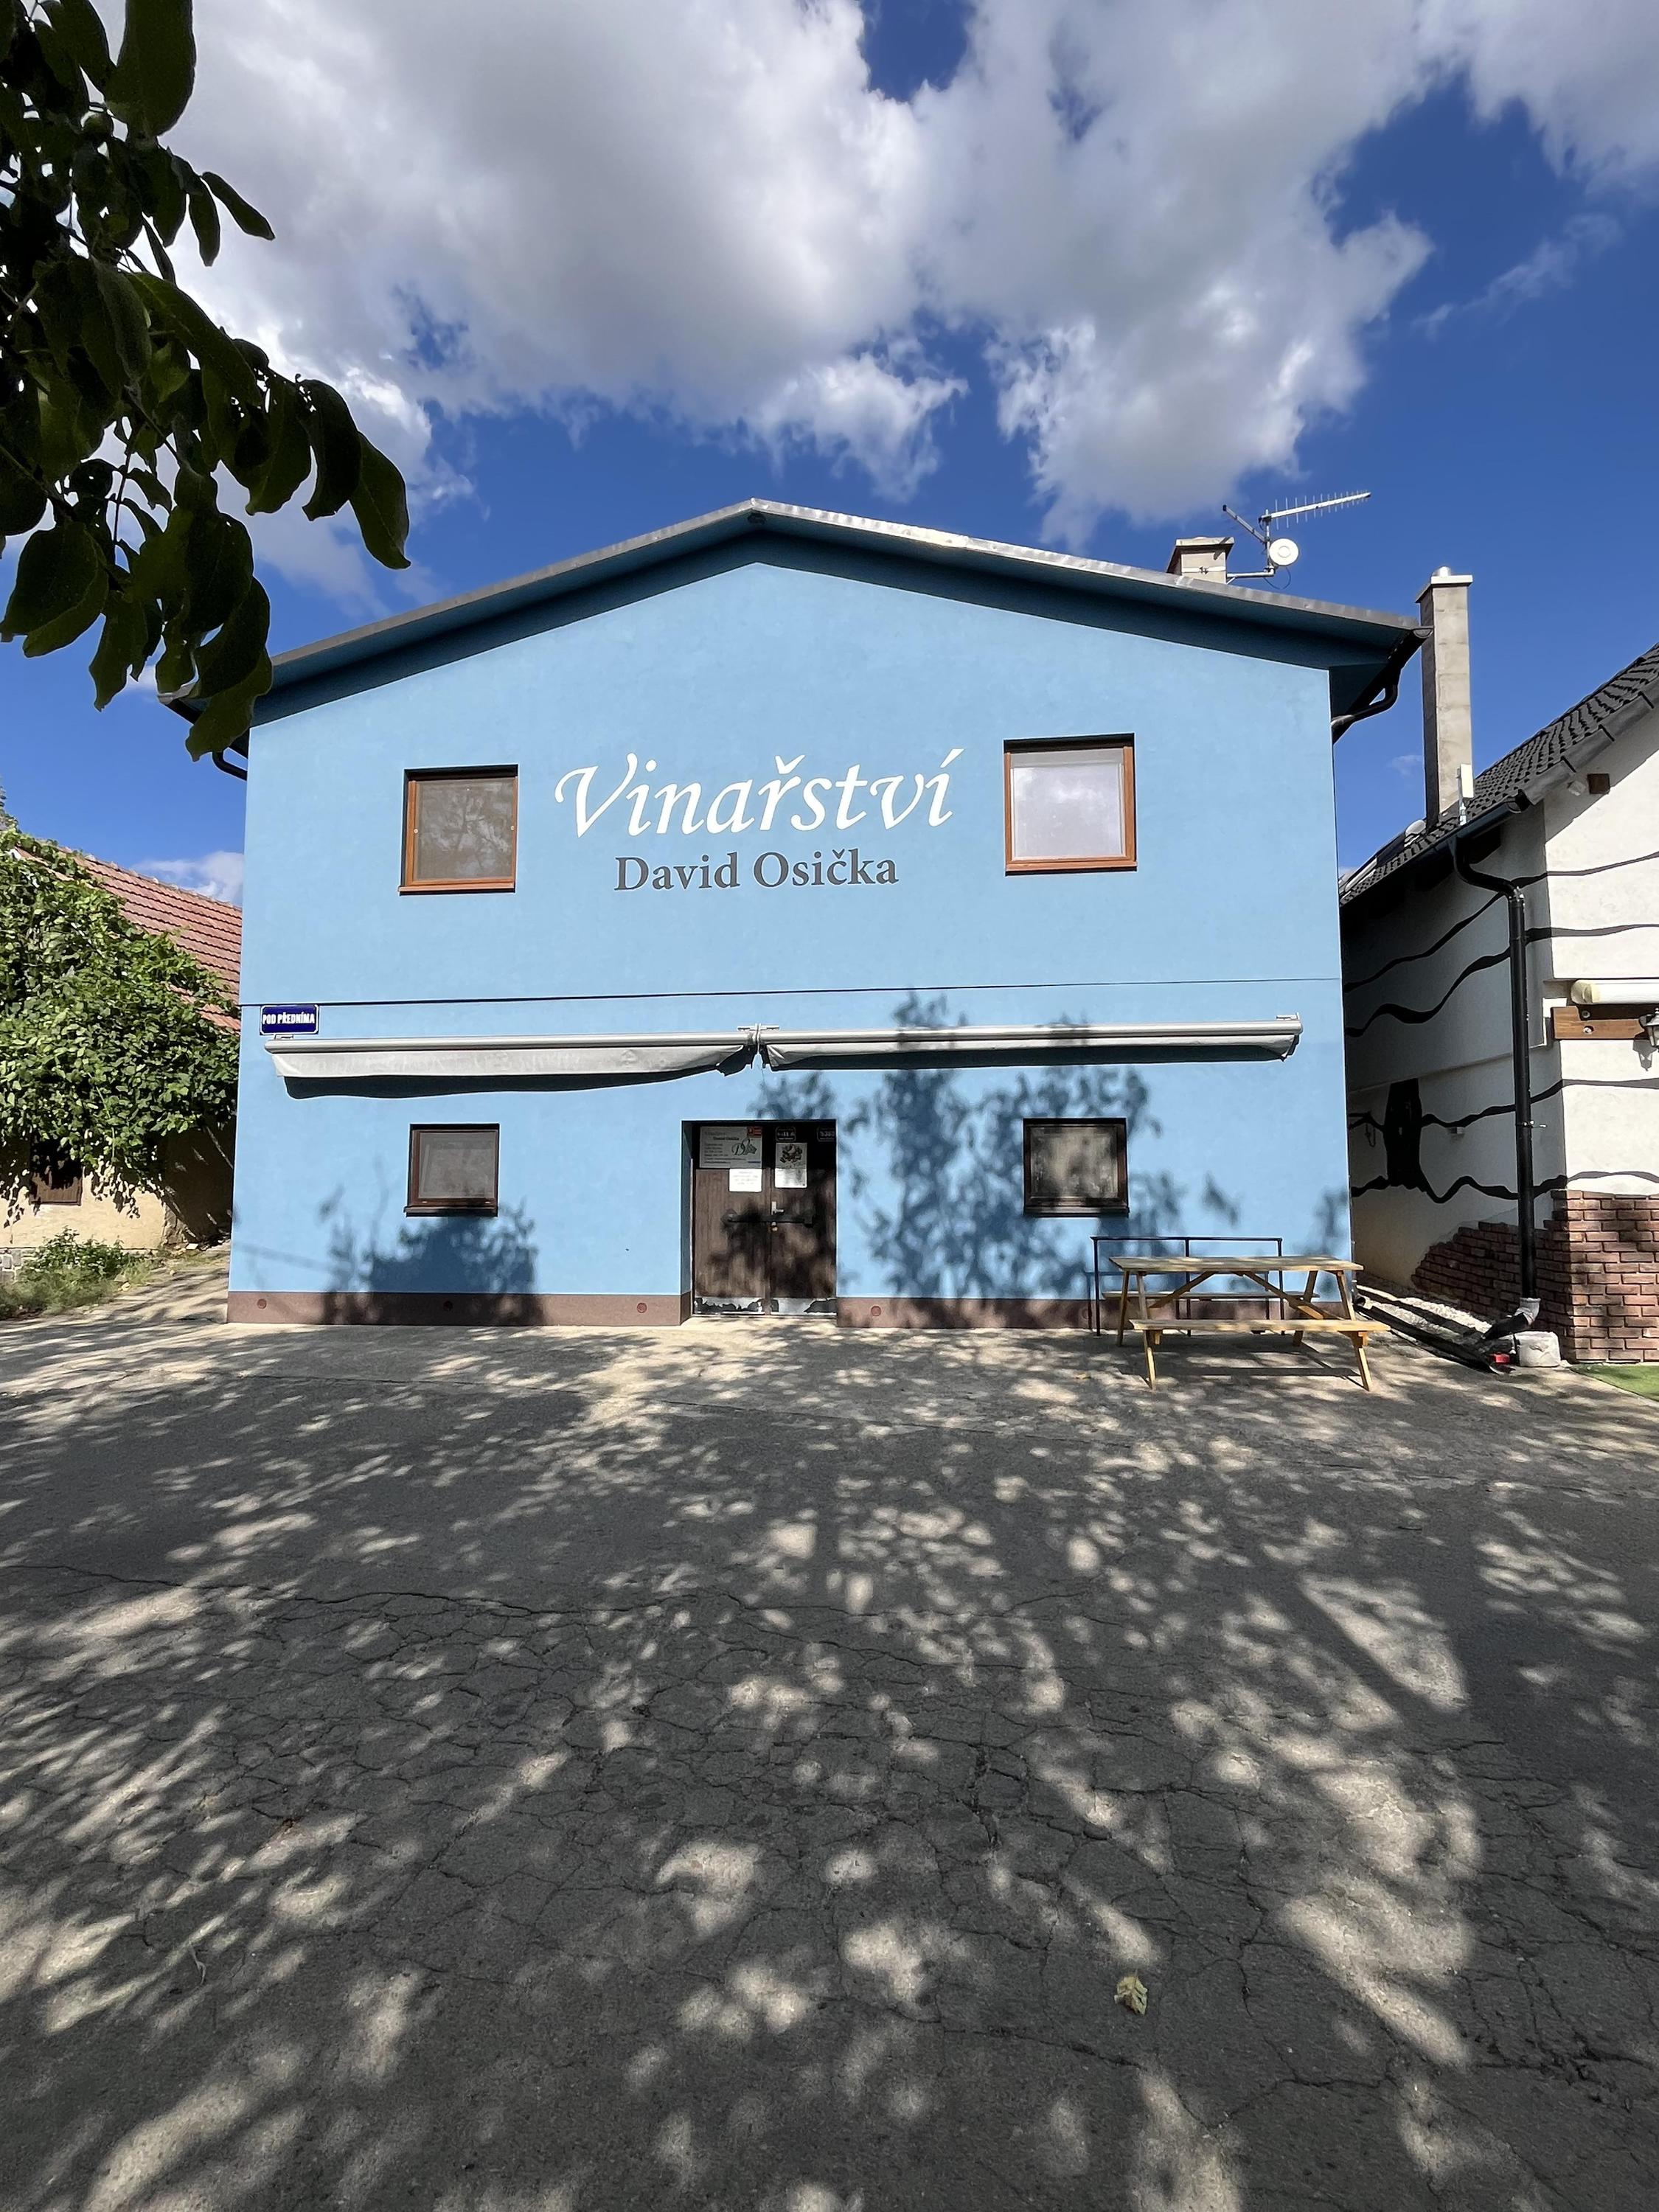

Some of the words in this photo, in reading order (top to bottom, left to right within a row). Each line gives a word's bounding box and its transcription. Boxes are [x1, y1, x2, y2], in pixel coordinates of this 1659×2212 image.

[554, 748, 964, 838] Vinařství
[614, 852, 740, 891] David
[753, 848, 900, 887] Osička
[262, 1013, 276, 1025] POD
[277, 1011, 316, 1024] PŘEDNÍMA
